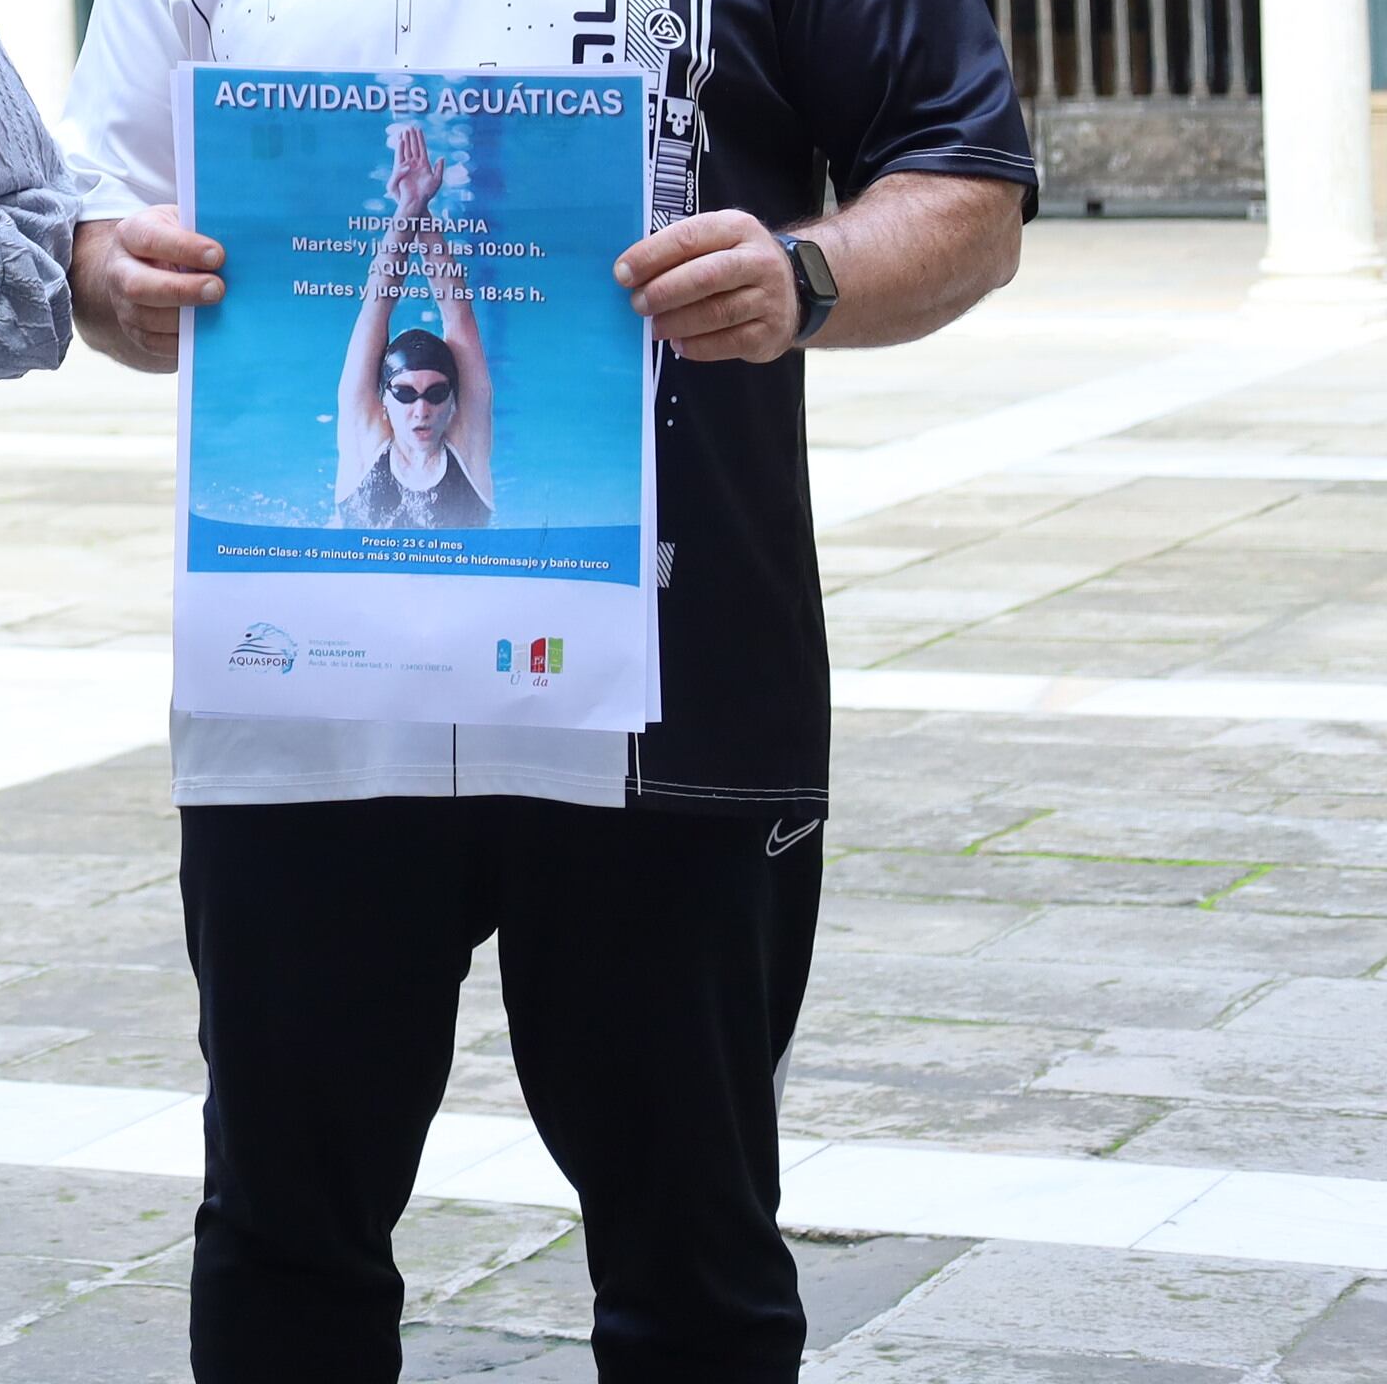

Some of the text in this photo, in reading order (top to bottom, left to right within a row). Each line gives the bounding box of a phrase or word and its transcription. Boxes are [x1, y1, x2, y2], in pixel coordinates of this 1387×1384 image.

[214, 80, 623, 116] ACTIVIDADES ACUÁTICAS
[348, 215, 488, 234] HIDROTERAPIA
[291, 236, 546, 258] Martes y jueves a las 10:00 h.
[367, 260, 468, 279] AQUAGYM:
[293, 280, 546, 303] Martes y jueves a las 18:45 h.
[362, 536, 463, 550] Precio: 23 € al mes
[217, 545, 609, 569] Duración Clase: 45 minutos más 30 minutos de hidromasaje y baño turco
[229, 656, 294, 667] AQUASPORT
[308, 649, 366, 658] AQUASPORT
